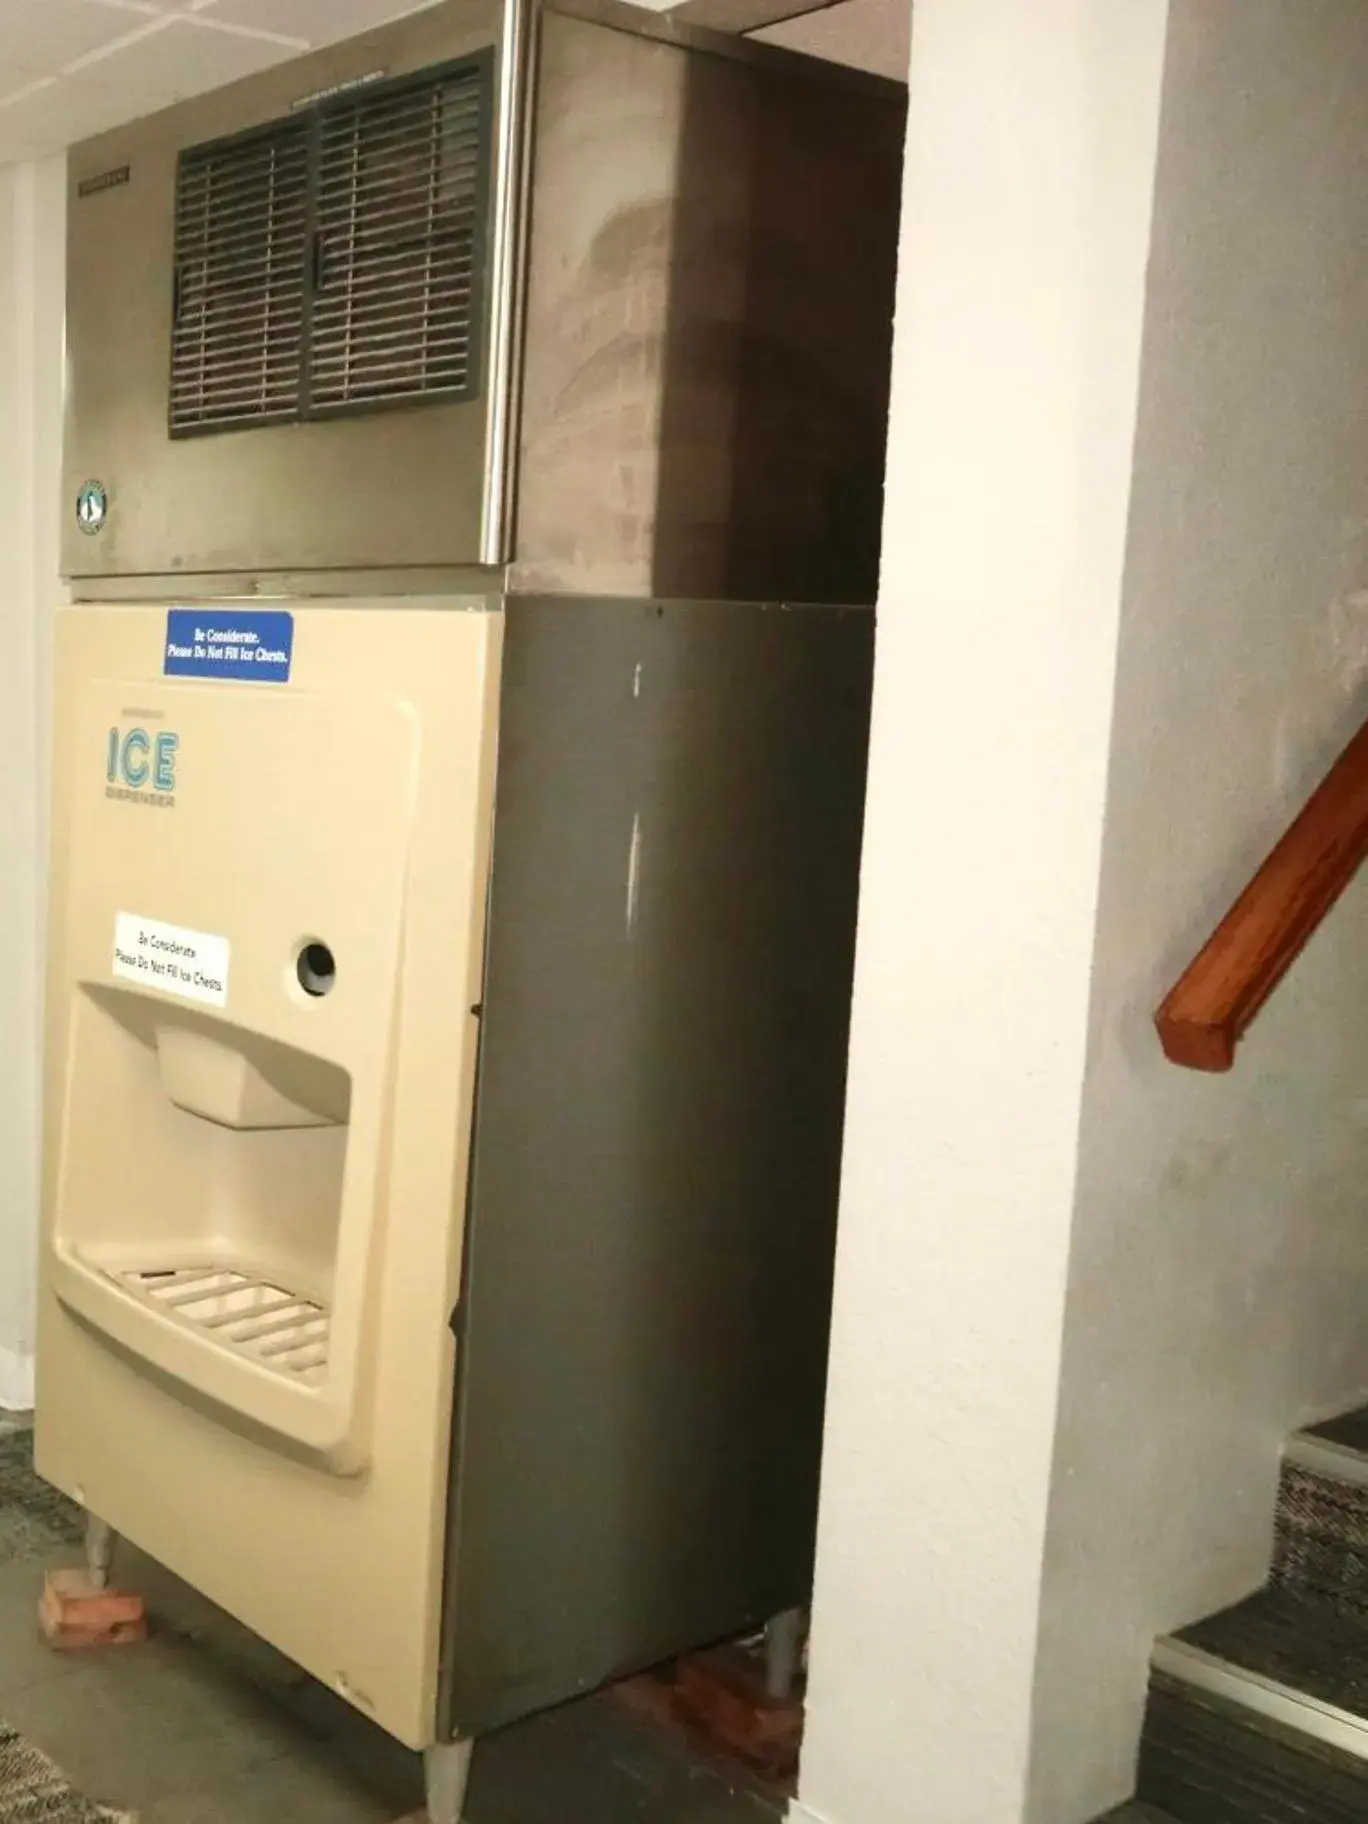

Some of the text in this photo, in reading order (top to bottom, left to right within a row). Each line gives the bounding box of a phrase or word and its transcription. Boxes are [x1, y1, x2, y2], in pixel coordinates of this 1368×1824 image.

[193, 628, 261, 644] Be Considerate.
[167, 643, 193, 658] Please
[194, 645, 206, 658] Do
[207, 645, 223, 659] Not
[224, 645, 239, 660] Fill
[240, 647, 254, 661] Ice
[107, 726, 179, 791] ICE
[138, 930, 148, 946] Be
[115, 948, 137, 965] Please
[138, 955, 148, 970] Do
[150, 959, 165, 975] Not
[167, 963, 178, 979] Fill
[181, 968, 192, 983] Ice
